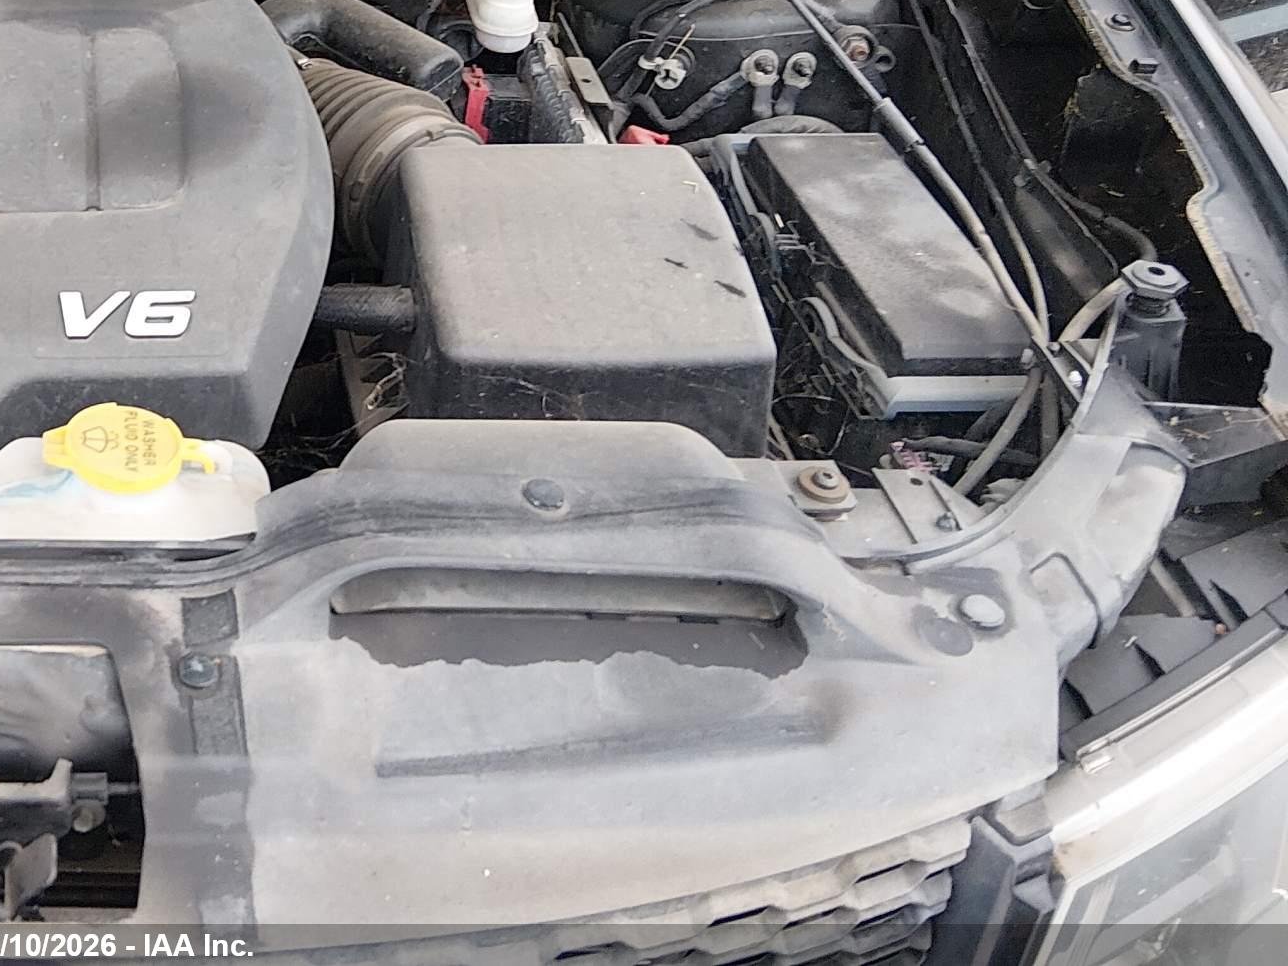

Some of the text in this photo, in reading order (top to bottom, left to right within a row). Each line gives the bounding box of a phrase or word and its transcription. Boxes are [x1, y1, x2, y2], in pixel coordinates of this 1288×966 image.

[58, 290, 196, 339] V6
[124, 410, 139, 473] FLUID ONLY
[142, 420, 157, 466] WASHER
